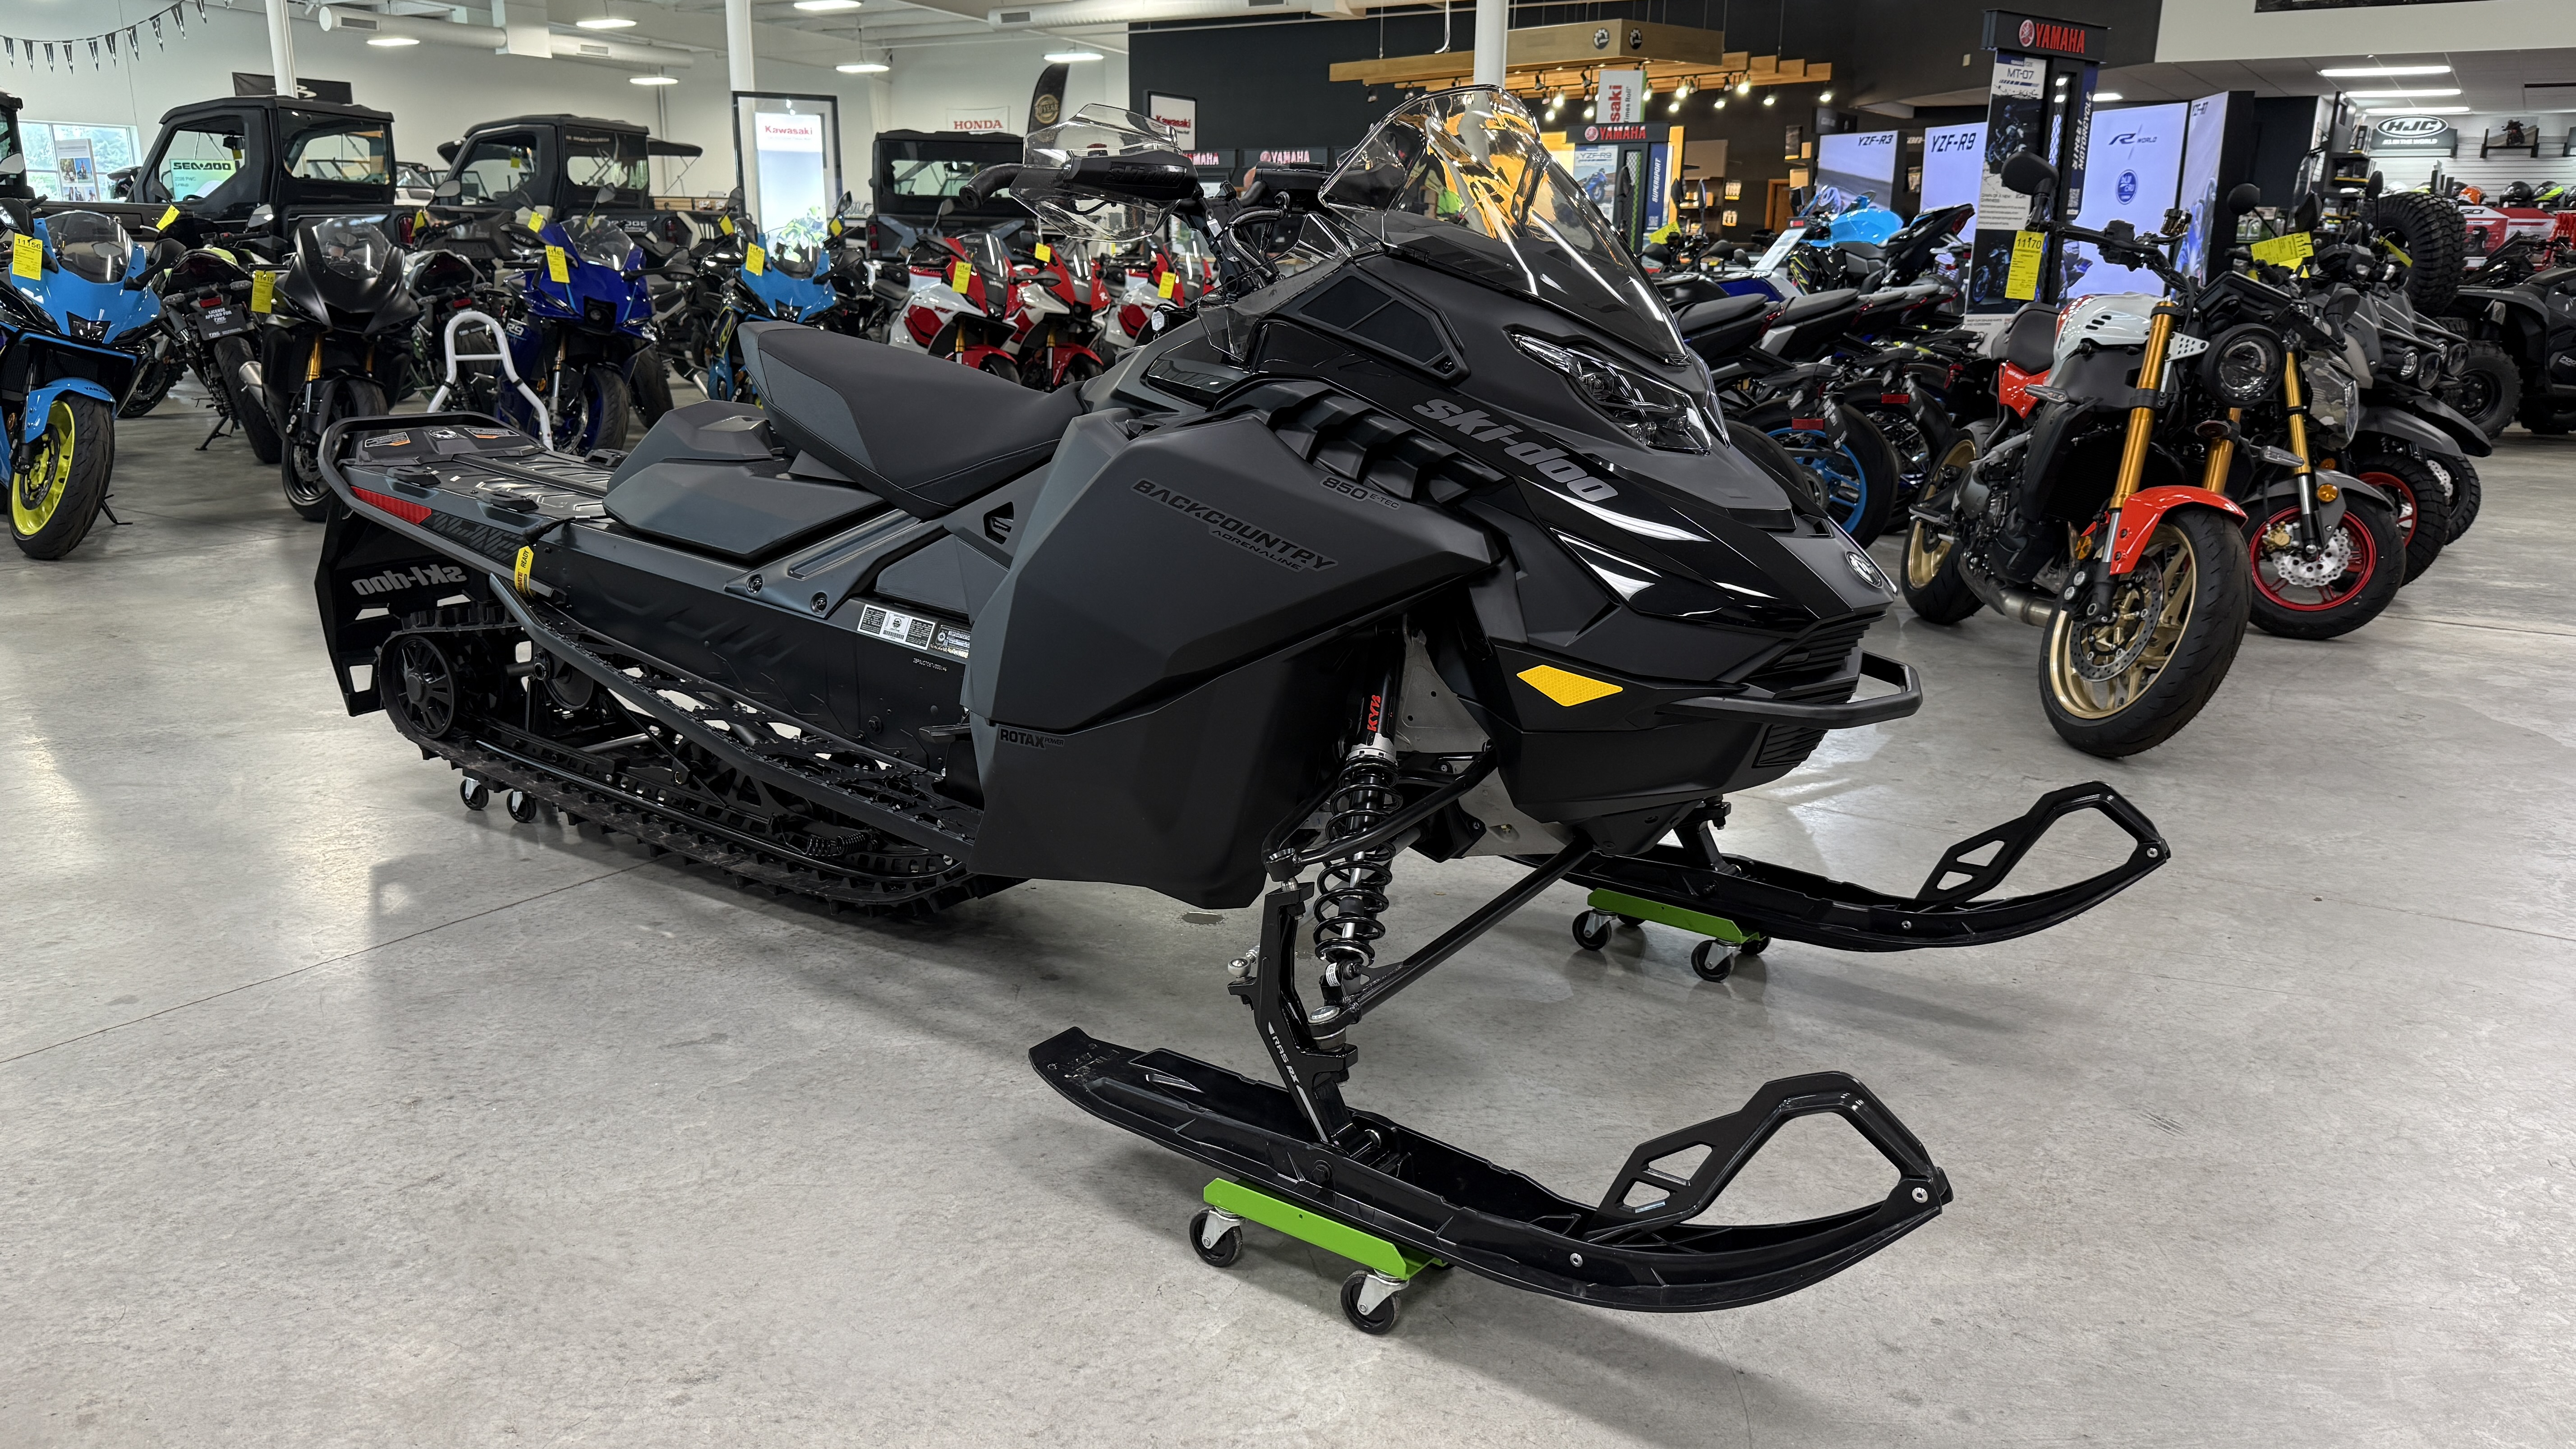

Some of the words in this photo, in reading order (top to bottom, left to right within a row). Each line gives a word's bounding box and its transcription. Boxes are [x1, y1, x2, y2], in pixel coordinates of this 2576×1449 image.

[2036, 23, 2084, 54] YAMAHA
[2007, 68, 2034, 80] MT-07
[1608, 85, 1623, 122] saki
[765, 125, 813, 135] Kawasaki
[953, 120, 1003, 130] HONDA
[1600, 125, 1646, 140] YAMAHA
[2078, 91, 2093, 170] MOTORCYCLE
[2386, 120, 2439, 131] HJC
[1858, 135, 1894, 147] YZF-R3
[1931, 133, 1977, 152] YZF-R9
[1271, 151, 1310, 164] YAMAHA
[1651, 158, 1661, 202] SUPERSPORT
[17, 238, 41, 249] 11156
[2017, 238, 2042, 249] 11170
[506, 322, 524, 336] R9
[1323, 477, 1368, 500] 850
[1370, 493, 1399, 508] E-TEC
[1132, 479, 1337, 570] BACKCOUNTRY
[520, 549, 529, 568] READY
[1212, 530, 1302, 570] ADRENALINE
[1367, 695, 1381, 731] KYB
[1000, 728, 1045, 749] ROTAX
[1044, 737, 1064, 745] POWER
[1272, 1035, 1289, 1063] RAS
[1286, 1065, 1300, 1083] RX
